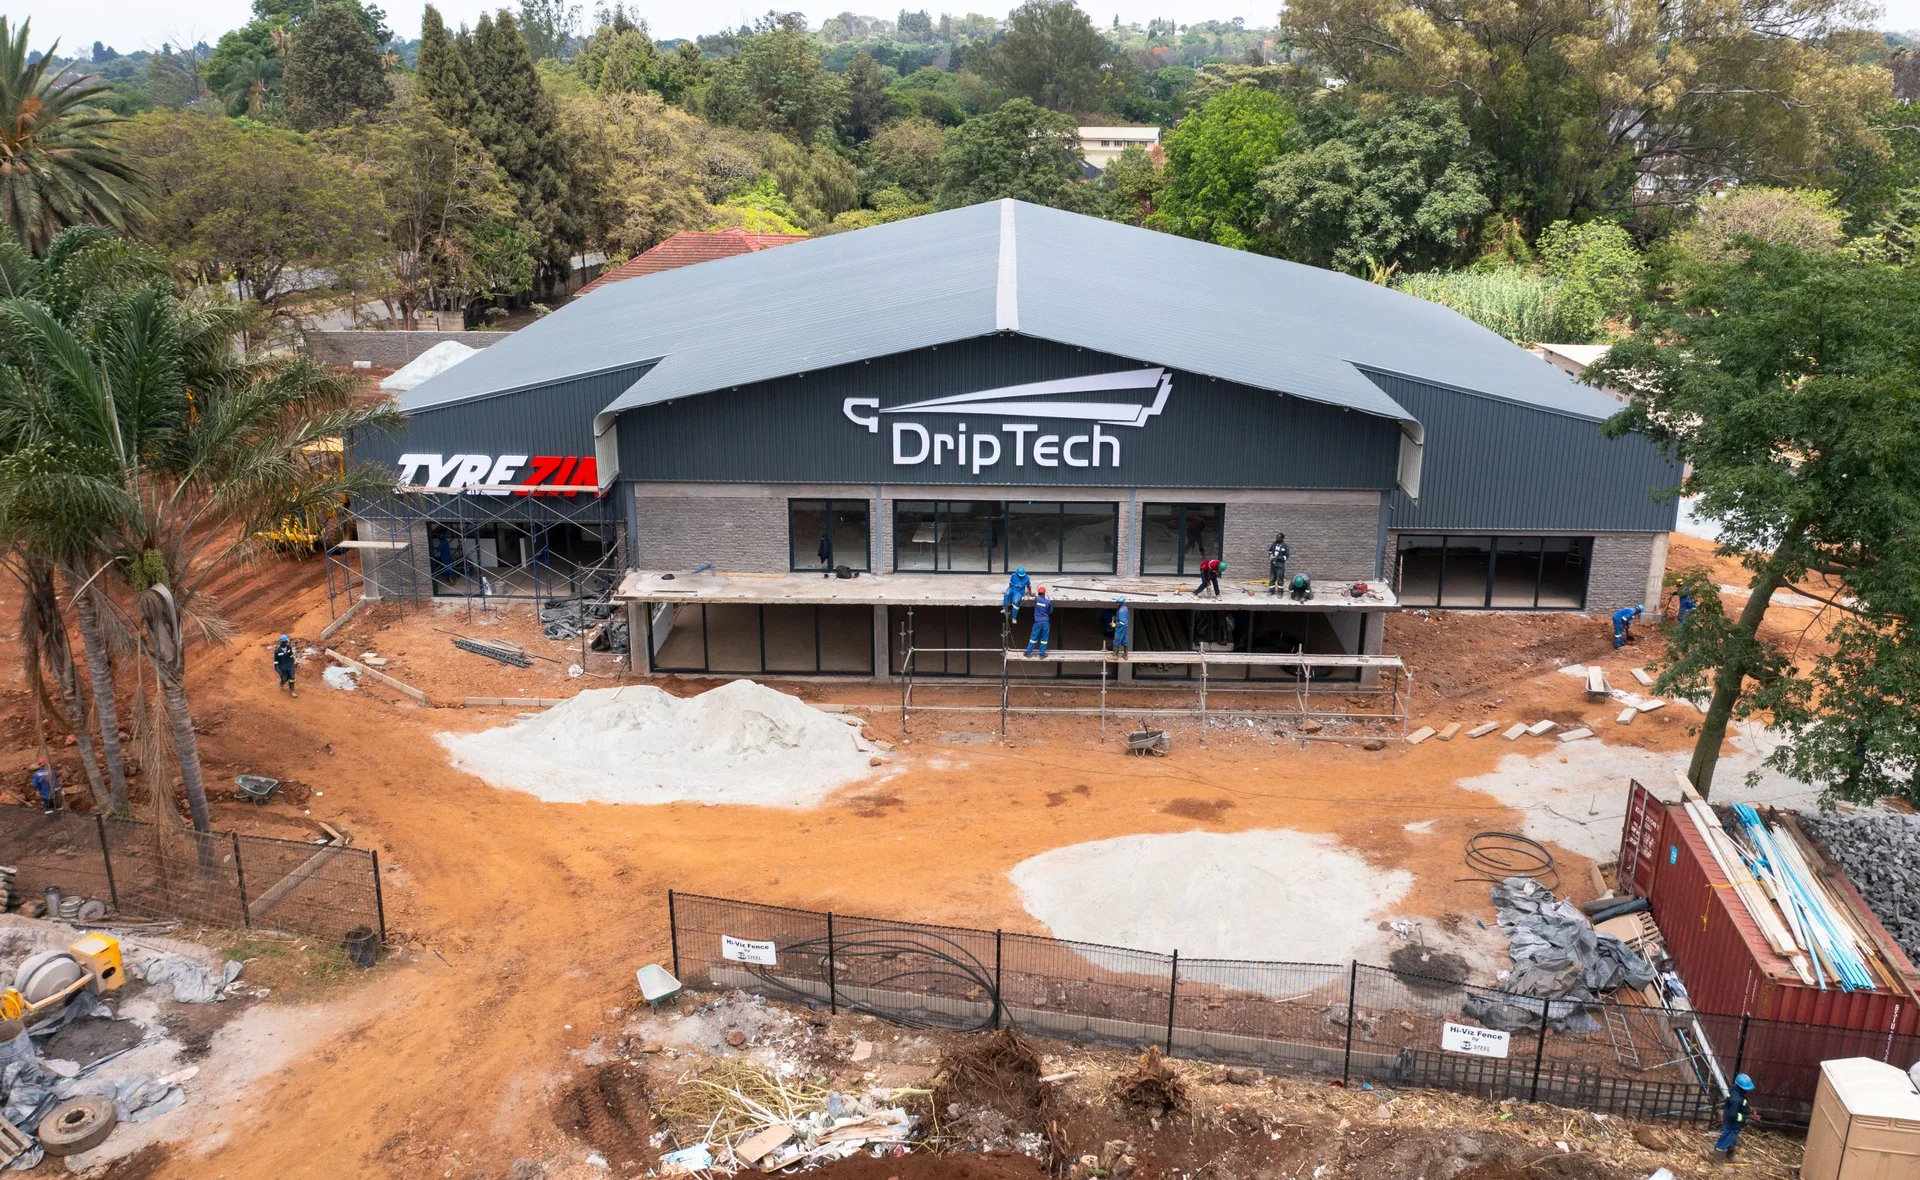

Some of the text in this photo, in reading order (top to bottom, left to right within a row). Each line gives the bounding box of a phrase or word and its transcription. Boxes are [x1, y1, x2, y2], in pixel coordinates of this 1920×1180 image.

[893, 423, 1121, 474] DripTech
[396, 453, 528, 496] TYRE
[727, 939, 745, 948] Hi-Viz
[1450, 1026, 1503, 1040] Hi-Viz Fence
[1473, 1044, 1490, 1052] STEEL
